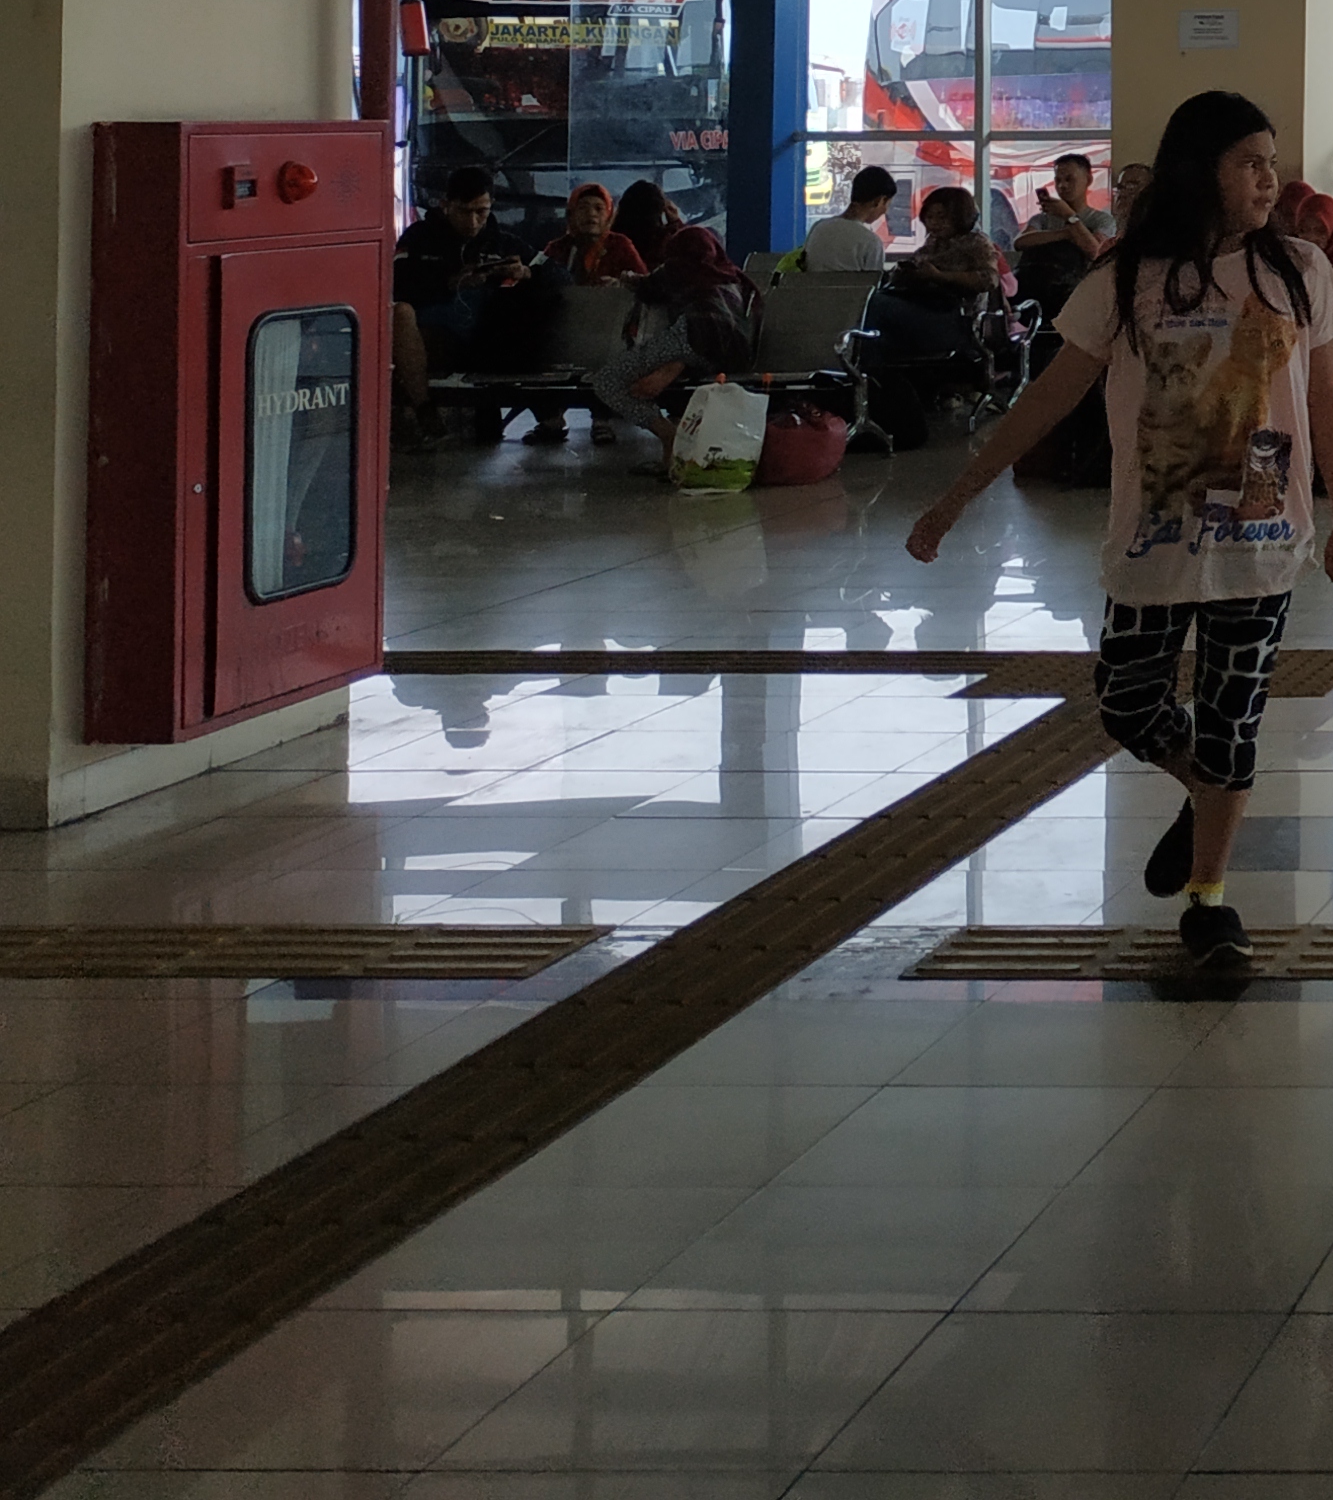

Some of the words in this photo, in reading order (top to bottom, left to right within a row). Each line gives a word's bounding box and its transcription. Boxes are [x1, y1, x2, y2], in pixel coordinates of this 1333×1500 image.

[490, 24, 571, 37] JAKARTA
[585, 26, 676, 40] KUNINGAN
[669, 130, 699, 151] VIA
[257, 383, 350, 417] HYDRANT
